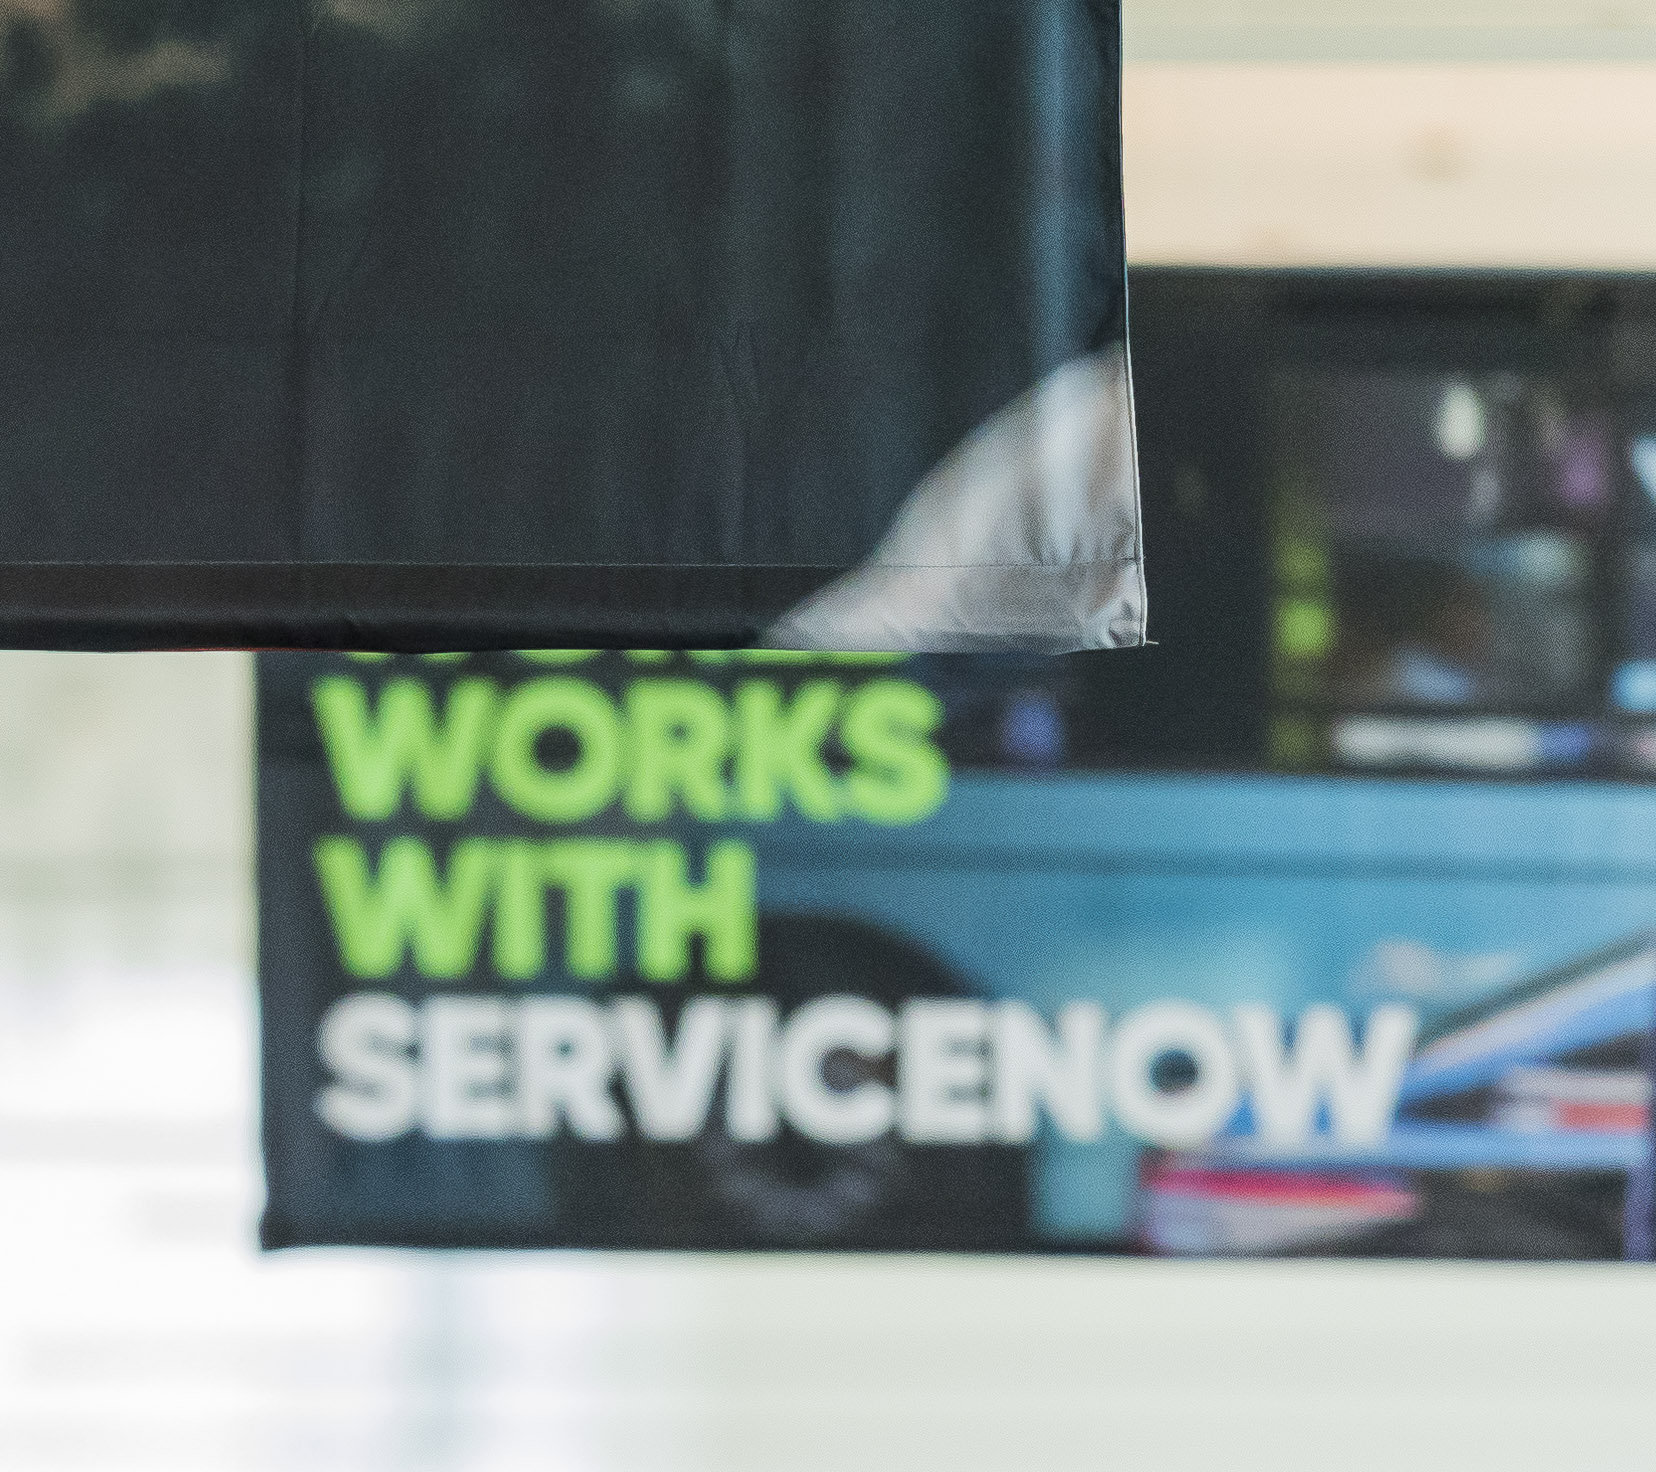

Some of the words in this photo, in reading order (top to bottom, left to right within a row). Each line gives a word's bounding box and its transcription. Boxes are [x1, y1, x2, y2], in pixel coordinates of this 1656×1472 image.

[313, 675, 948, 824] WORKS
[315, 837, 758, 982] WITH
[315, 994, 1420, 1146] SERVICENOW
